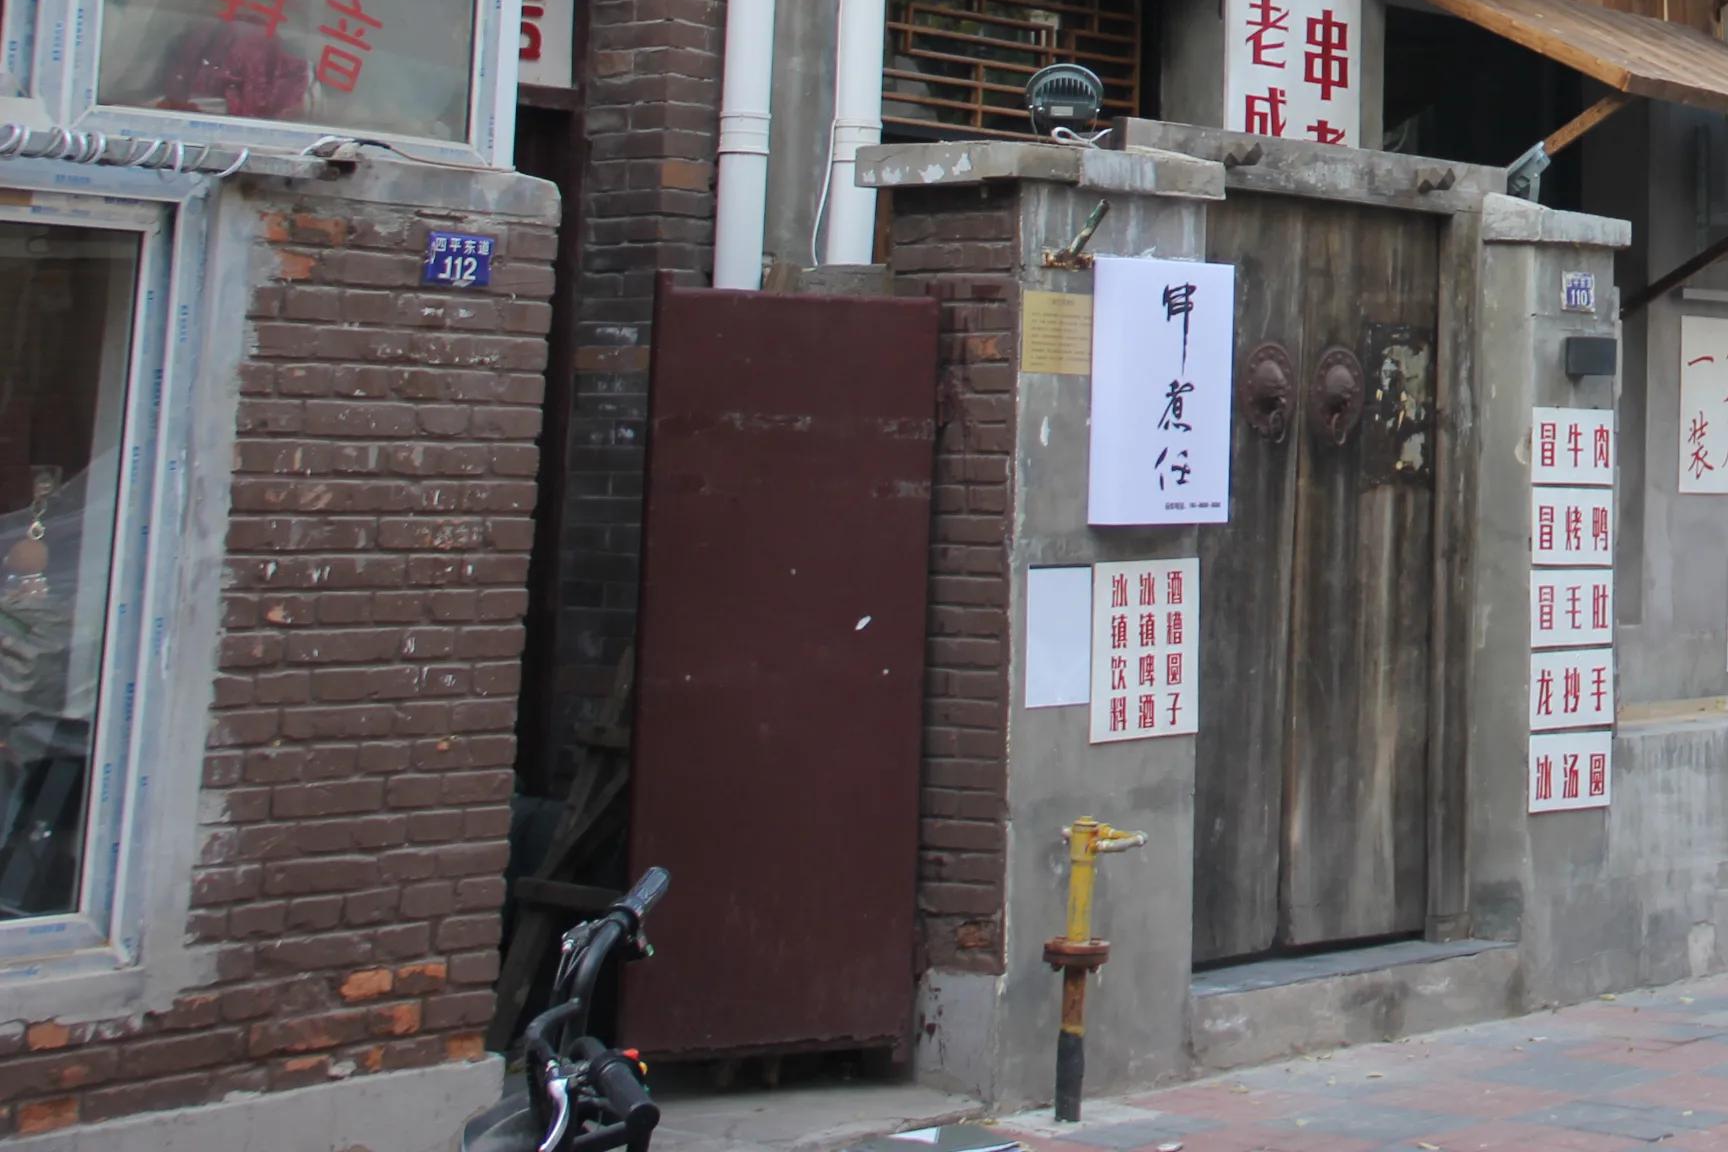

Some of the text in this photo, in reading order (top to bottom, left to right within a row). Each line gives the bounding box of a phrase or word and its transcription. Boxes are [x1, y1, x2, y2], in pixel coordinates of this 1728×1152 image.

[434, 237, 490, 255] 四平东道
[438, 256, 478, 281] 112
[1571, 288, 1588, 305] 110
[1541, 423, 1610, 469] 冒牛肉
[1538, 505, 1609, 551] 冒烤鸭
[1538, 584, 1609, 630] 冒毛肚
[1109, 573, 1128, 731] 冰镇饮料
[1138, 572, 1156, 729] 冰镇啤酒
[1536, 666, 1607, 716] 龙抄手
[1535, 753, 1606, 800] 冰汤圆
